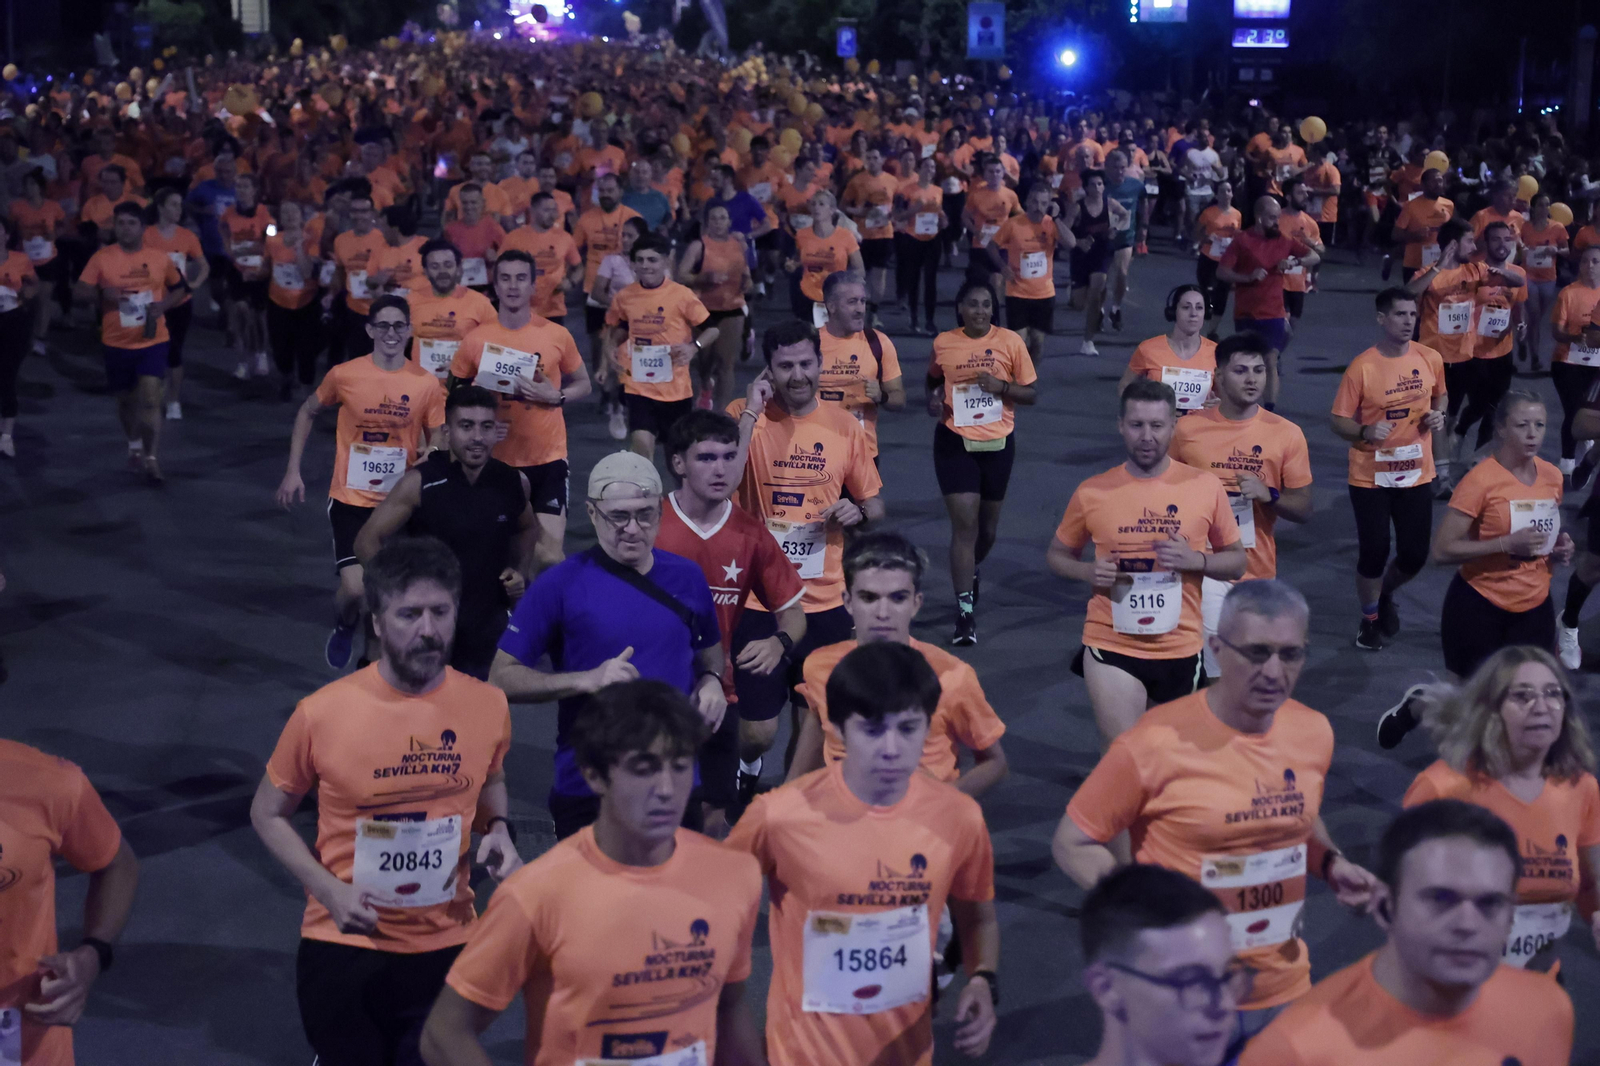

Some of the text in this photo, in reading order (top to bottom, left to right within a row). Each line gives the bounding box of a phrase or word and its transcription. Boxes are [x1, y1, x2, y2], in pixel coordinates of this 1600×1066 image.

[494, 361, 522, 377] 9595
[1173, 381, 1202, 394] 17309
[1385, 386, 1409, 396] SEVILLA
[963, 396, 994, 409] 12756
[364, 407, 393, 416] SEVILLA
[789, 454, 827, 464] NOCTURNA
[1227, 456, 1264, 466] NOCTURNA
[1387, 459, 1416, 472] 17299
[362, 460, 395, 474] 19632
[772, 460, 826, 472] SEVILLA KH7
[1210, 462, 1263, 473] SEVILLA KH7
[1137, 518, 1181, 526] NOCTURNA
[1117, 525, 1156, 534] SEVILLA
[782, 540, 815, 556] 5337
[1129, 593, 1165, 609] 5116
[401, 751, 462, 764] NOCTURNA
[373, 762, 461, 780] SEVILLA KH7
[1250, 792, 1305, 807] NOCTURNA
[1224, 808, 1279, 825] SEVILLA
[378, 848, 443, 872] 20843
[867, 879, 933, 892] NOCTURNA
[836, 892, 897, 906] SEVILLA
[1236, 881, 1284, 911] 1300
[643, 948, 716, 967] NOCTURNA
[833, 944, 908, 972] 15864
[612, 968, 676, 988] SEVILLA
